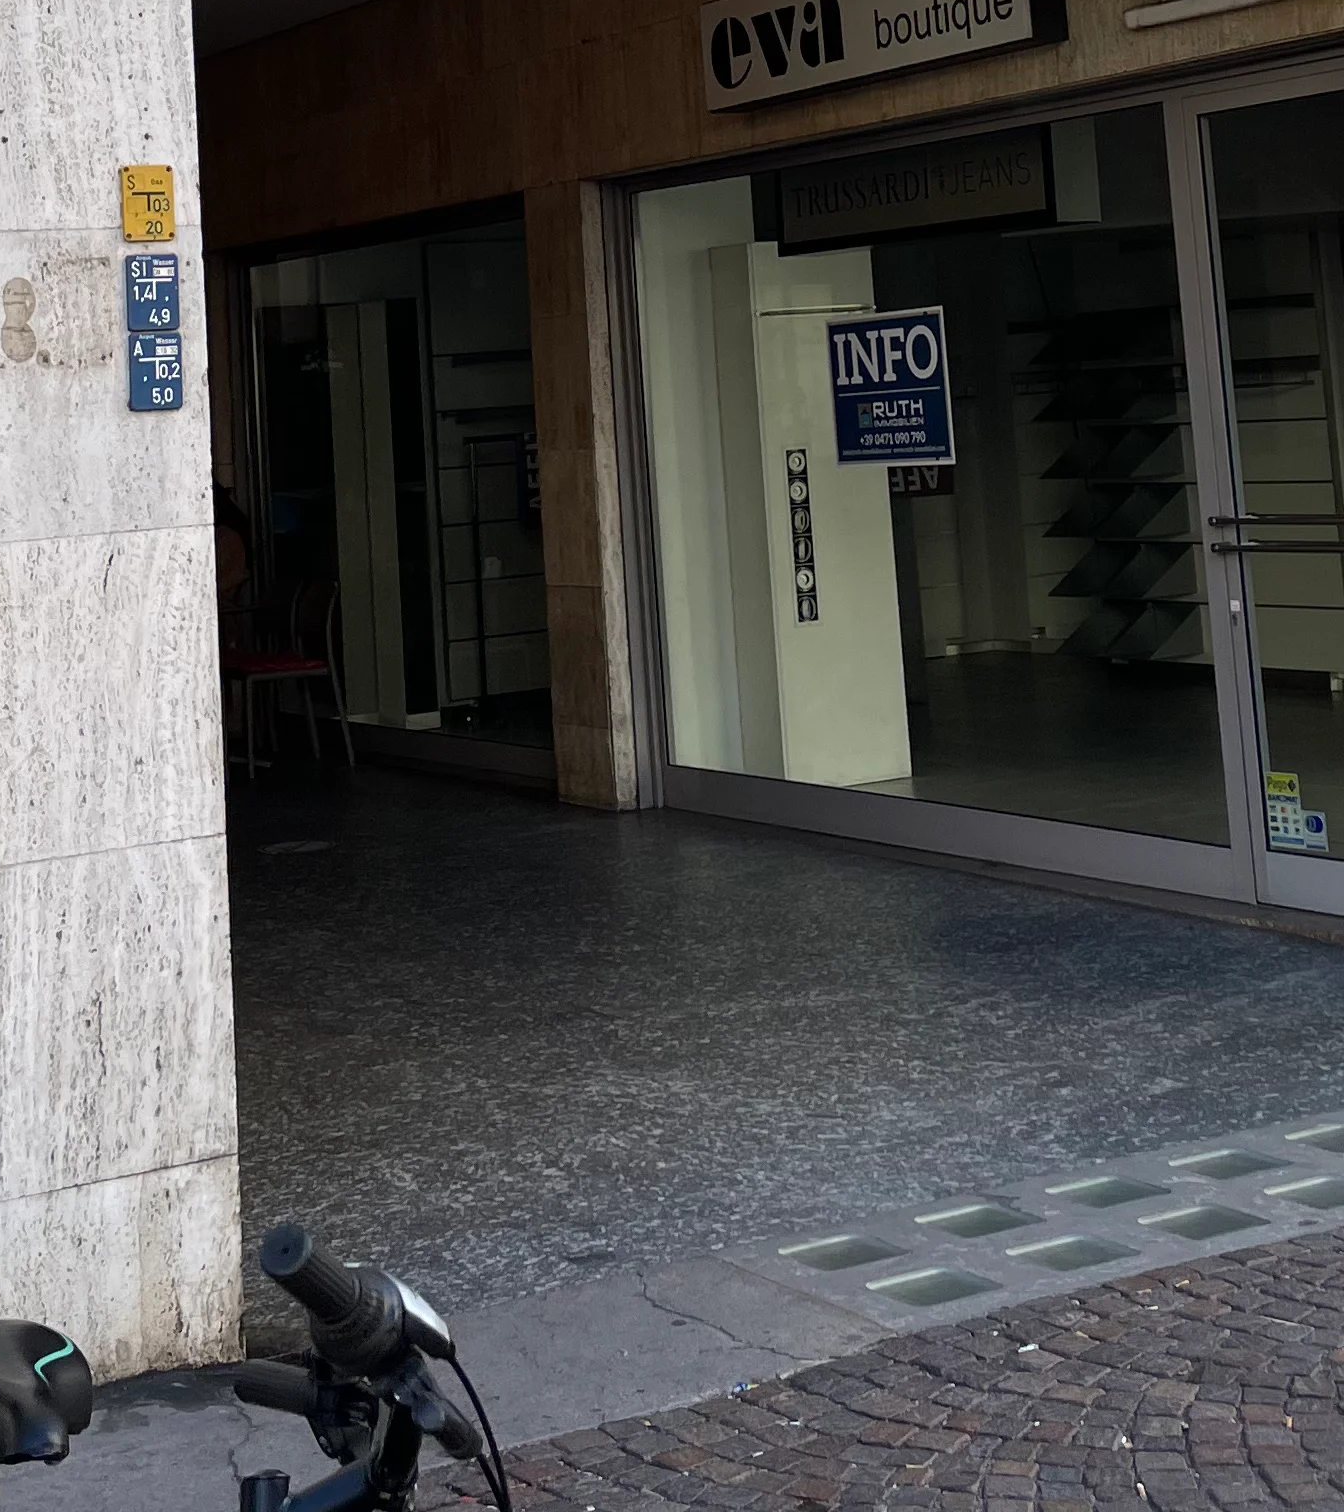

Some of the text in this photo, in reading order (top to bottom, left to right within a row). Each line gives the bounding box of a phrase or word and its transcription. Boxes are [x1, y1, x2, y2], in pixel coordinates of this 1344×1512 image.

[127, 174, 135, 190] S
[791, 152, 1032, 219] TRUSSARDI JEANS
[153, 198, 170, 213] 03
[145, 221, 164, 235] 20
[134, 285, 153, 302] 1,4
[149, 309, 171, 327] 4,9
[133, 340, 144, 357] A
[834, 324, 939, 385] INFO
[159, 362, 181, 381] 0,2
[152, 387, 174, 405] 5,0
[872, 398, 924, 418] RUTH
[874, 433, 894, 445] 0471
